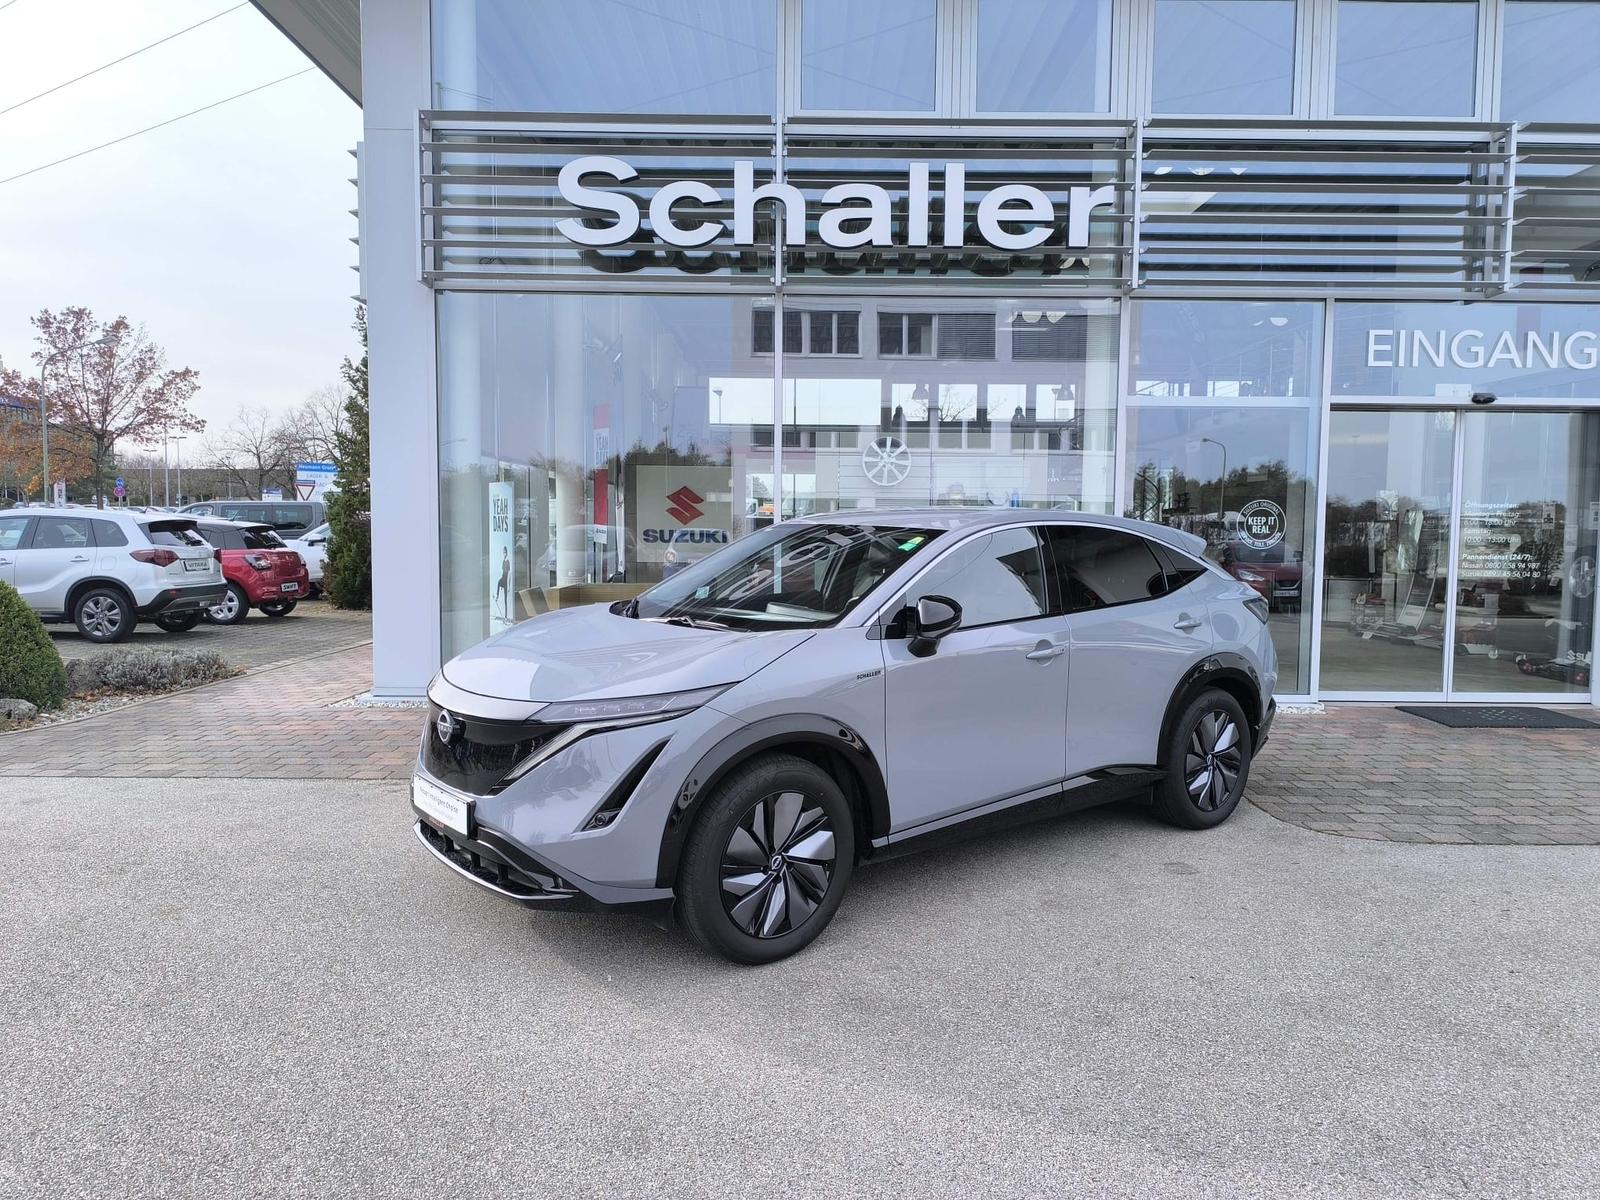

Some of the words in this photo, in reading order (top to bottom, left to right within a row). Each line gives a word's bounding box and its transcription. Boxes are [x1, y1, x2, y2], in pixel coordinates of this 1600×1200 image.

[555, 156, 1115, 249] Schaller
[1367, 329, 1598, 370] EINGANG
[492, 498, 508, 515] YEAH
[492, 516, 509, 533] DAYS
[1248, 516, 1266, 526] KEEP
[1268, 516, 1276, 526] IT
[1252, 525, 1271, 534] REAL
[642, 528, 728, 544] SUZUKI
